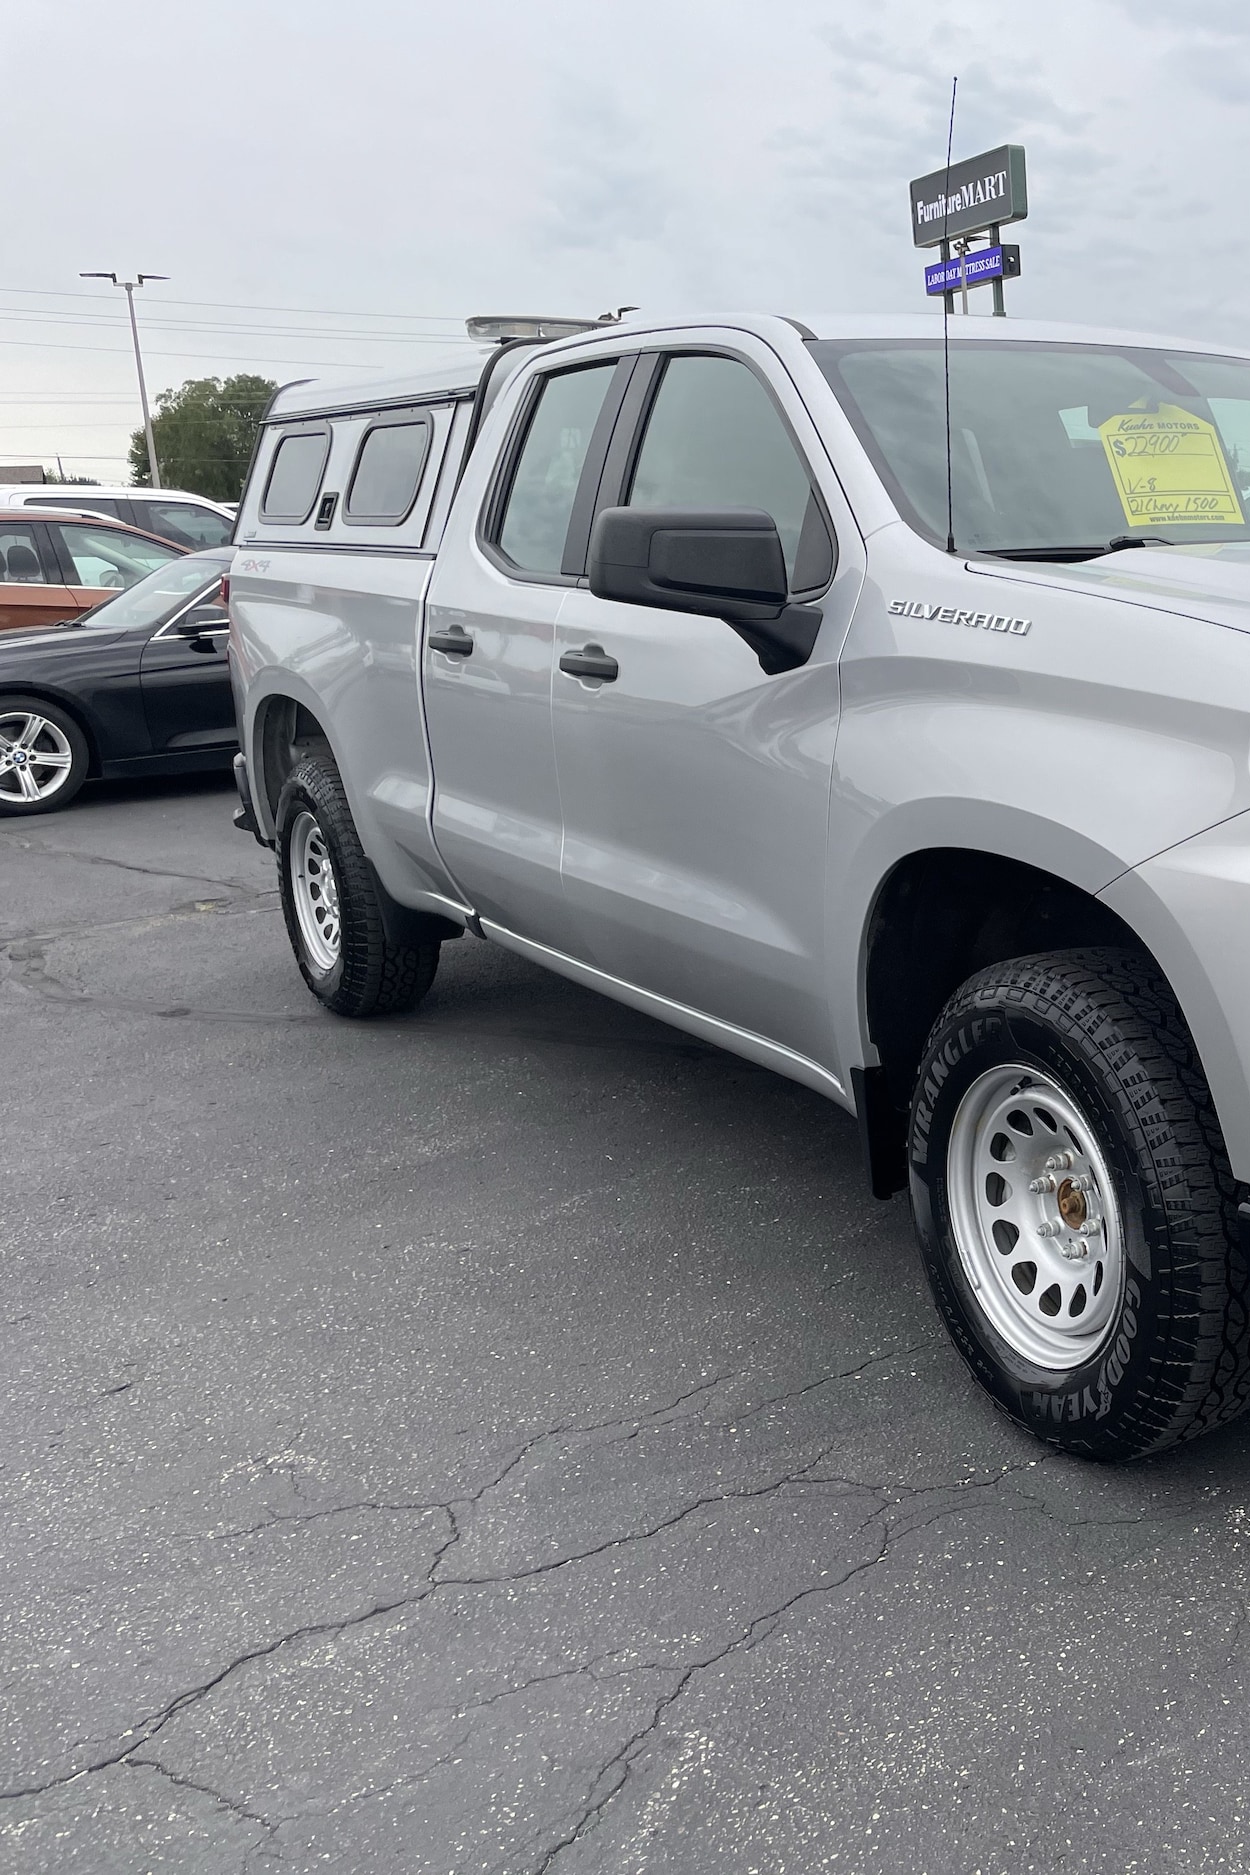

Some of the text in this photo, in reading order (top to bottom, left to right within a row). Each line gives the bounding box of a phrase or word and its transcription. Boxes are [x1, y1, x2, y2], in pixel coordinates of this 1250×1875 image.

[917, 170, 1007, 225] FurnitureMART
[927, 255, 1001, 286] LABOR DAY MTTRESS SALE
[1118, 419, 1200, 433] Kuehn MOTORS
[1127, 477, 1157, 493] V-8
[1185, 497, 1219, 512] 1500
[888, 599, 1033, 636] SILVERADO
[911, 1016, 1003, 1165] WRANGLER
